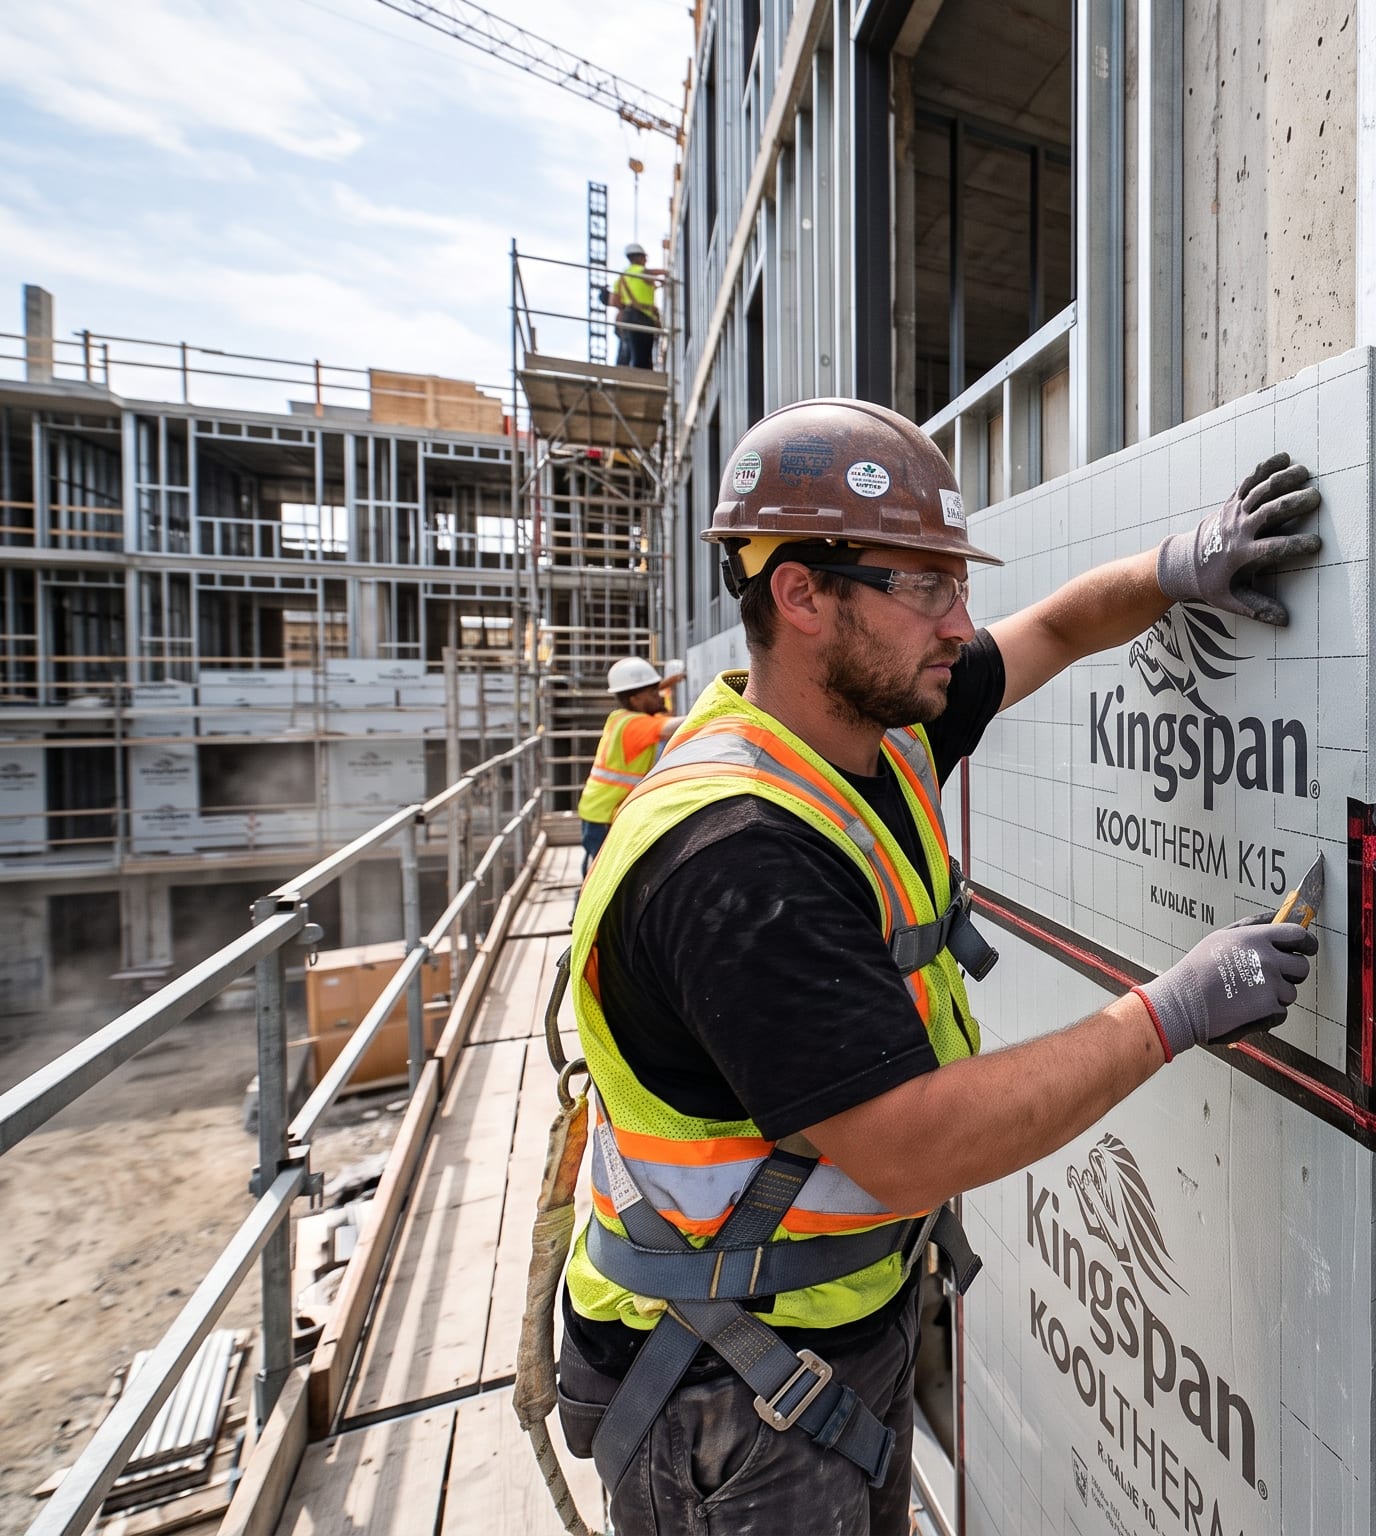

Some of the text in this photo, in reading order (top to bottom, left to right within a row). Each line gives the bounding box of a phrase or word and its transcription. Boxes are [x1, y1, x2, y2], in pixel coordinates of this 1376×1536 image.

[1096, 806, 1286, 896] KOOLTHERM K15
[1200, 902, 1215, 926] IN
